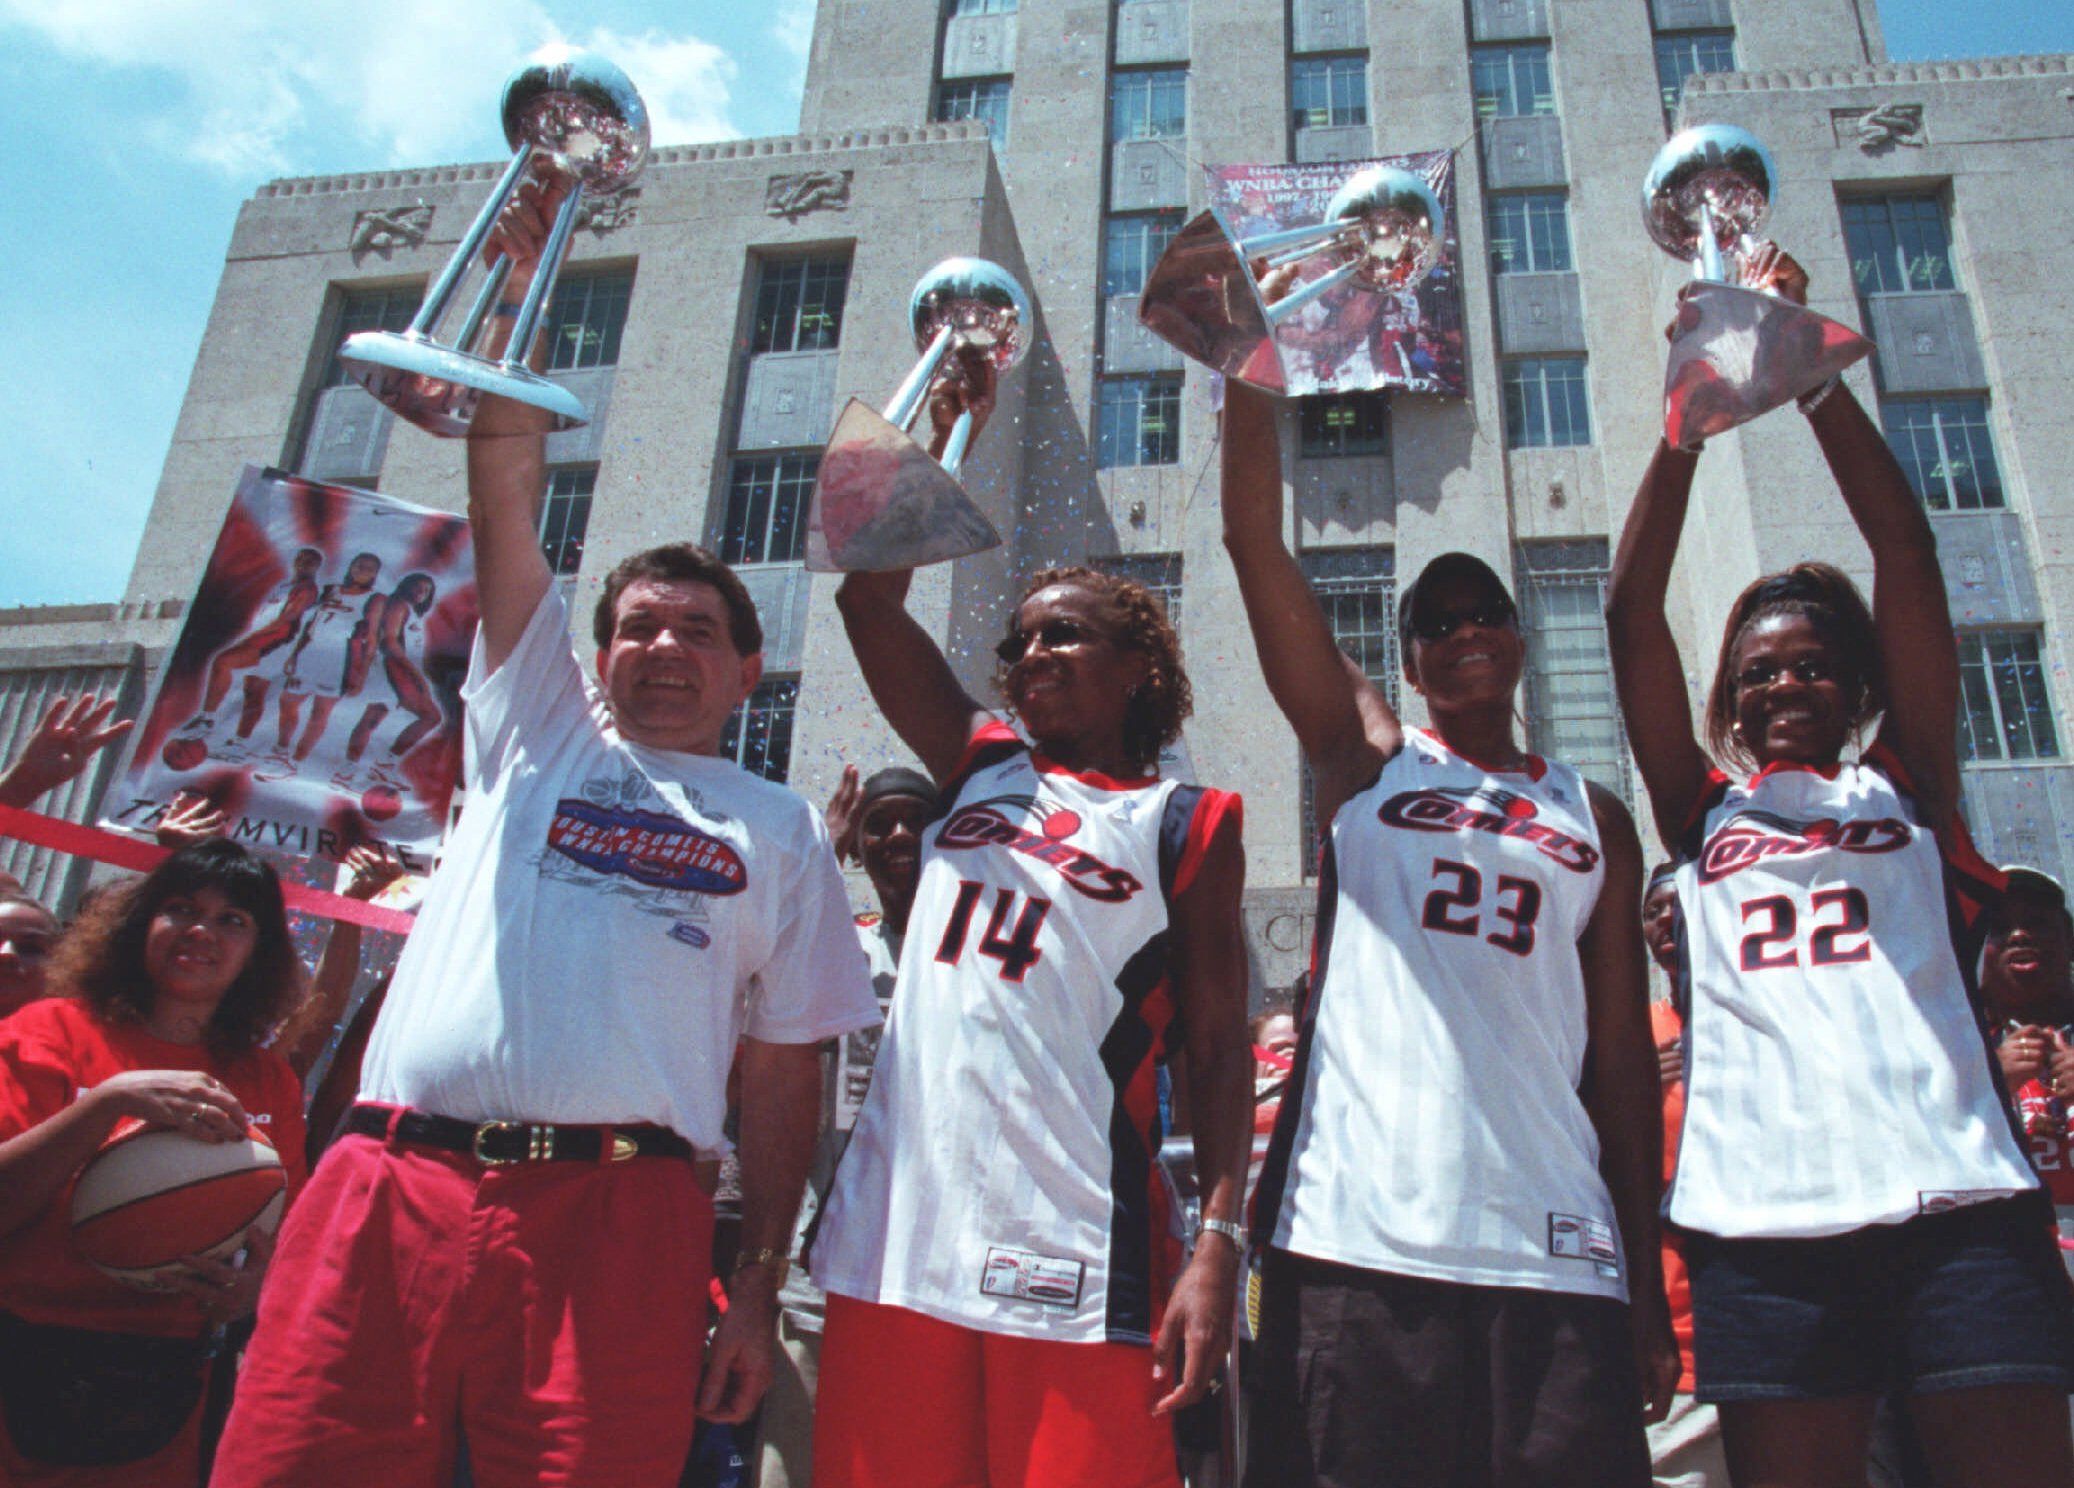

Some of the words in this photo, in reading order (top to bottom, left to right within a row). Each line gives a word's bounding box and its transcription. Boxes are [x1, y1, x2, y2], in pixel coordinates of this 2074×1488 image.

[1223, 178, 1293, 193] WNBA
[556, 816, 629, 841] OUSTN
[618, 840, 738, 878] CHAMPIONS
[934, 880, 1052, 984] 14
[1421, 857, 1542, 958] 23
[1740, 886, 1872, 972] 22
